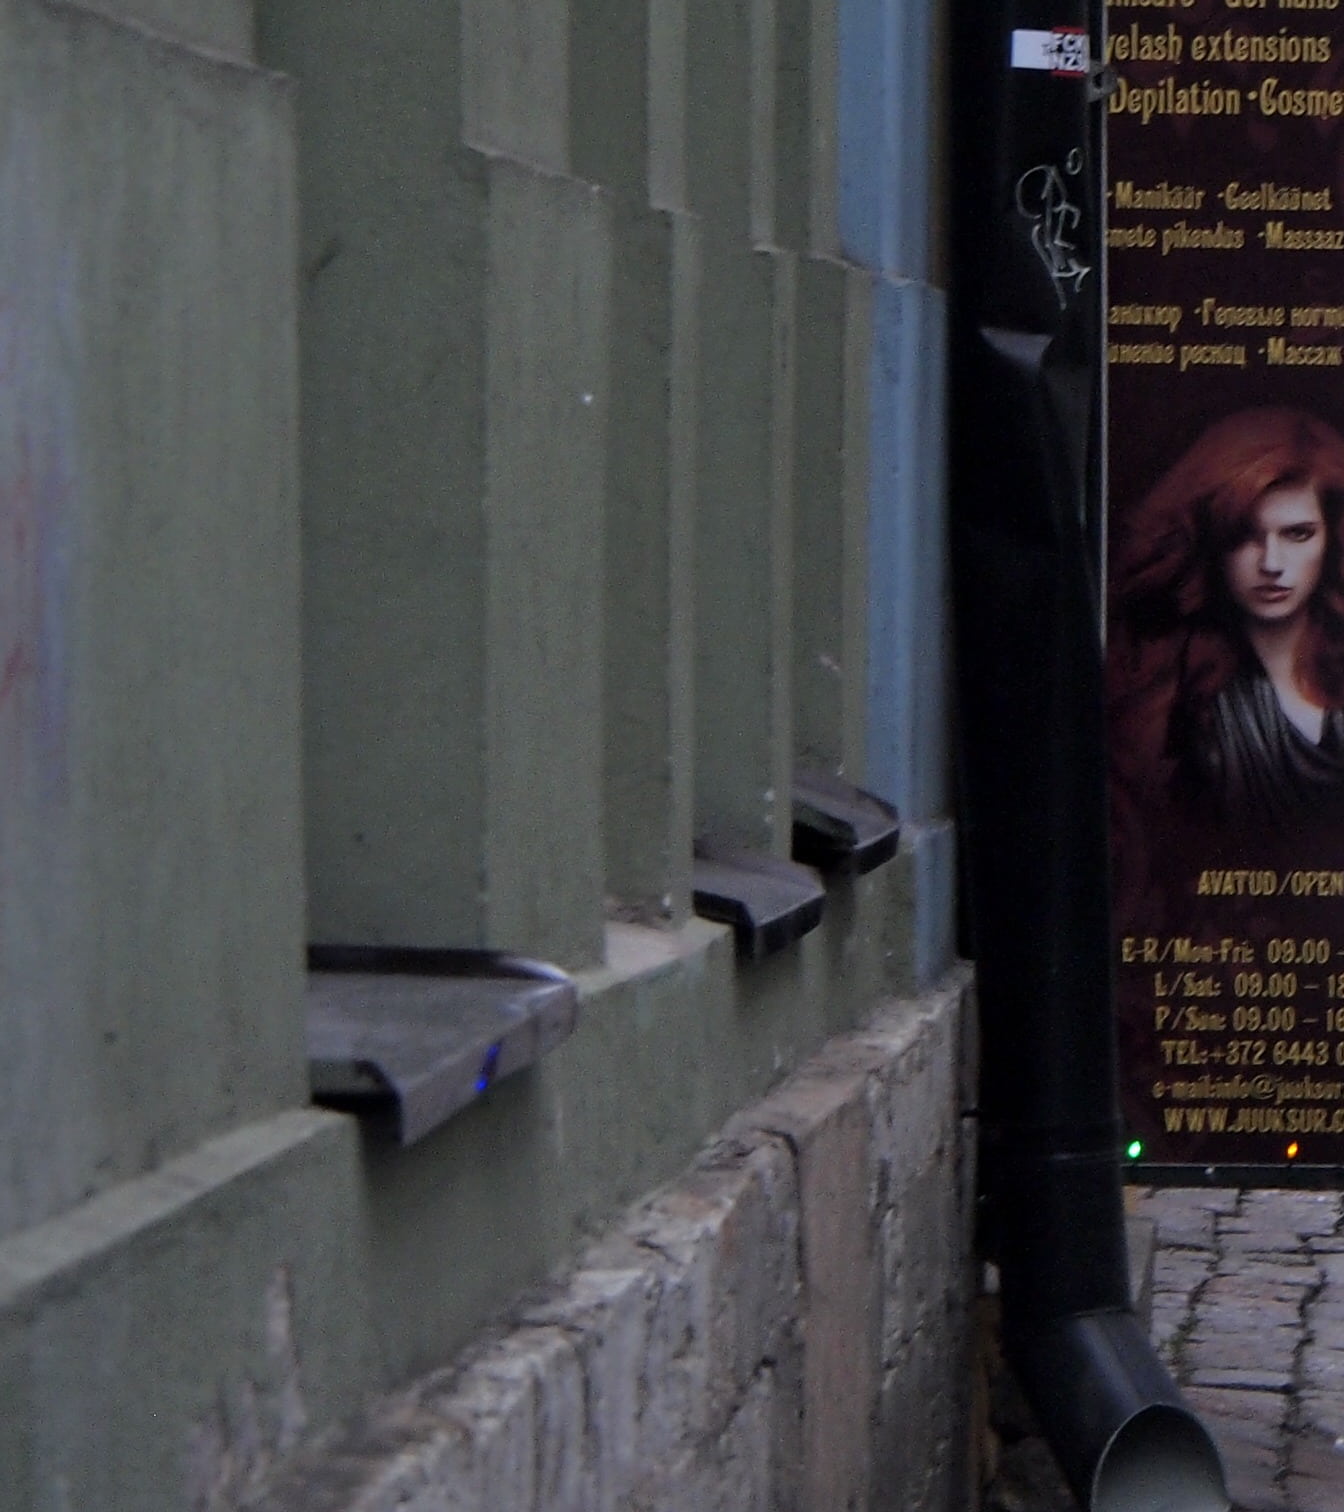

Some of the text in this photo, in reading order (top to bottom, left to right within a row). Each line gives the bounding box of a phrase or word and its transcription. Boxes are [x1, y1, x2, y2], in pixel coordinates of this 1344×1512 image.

[1191, 28, 1331, 62] extensions
[1267, 938, 1331, 964] 09.00
[1234, 972, 1297, 998] 09.00
[1232, 1006, 1296, 1032] 09.00
[1273, 1040, 1330, 1066] 6443
